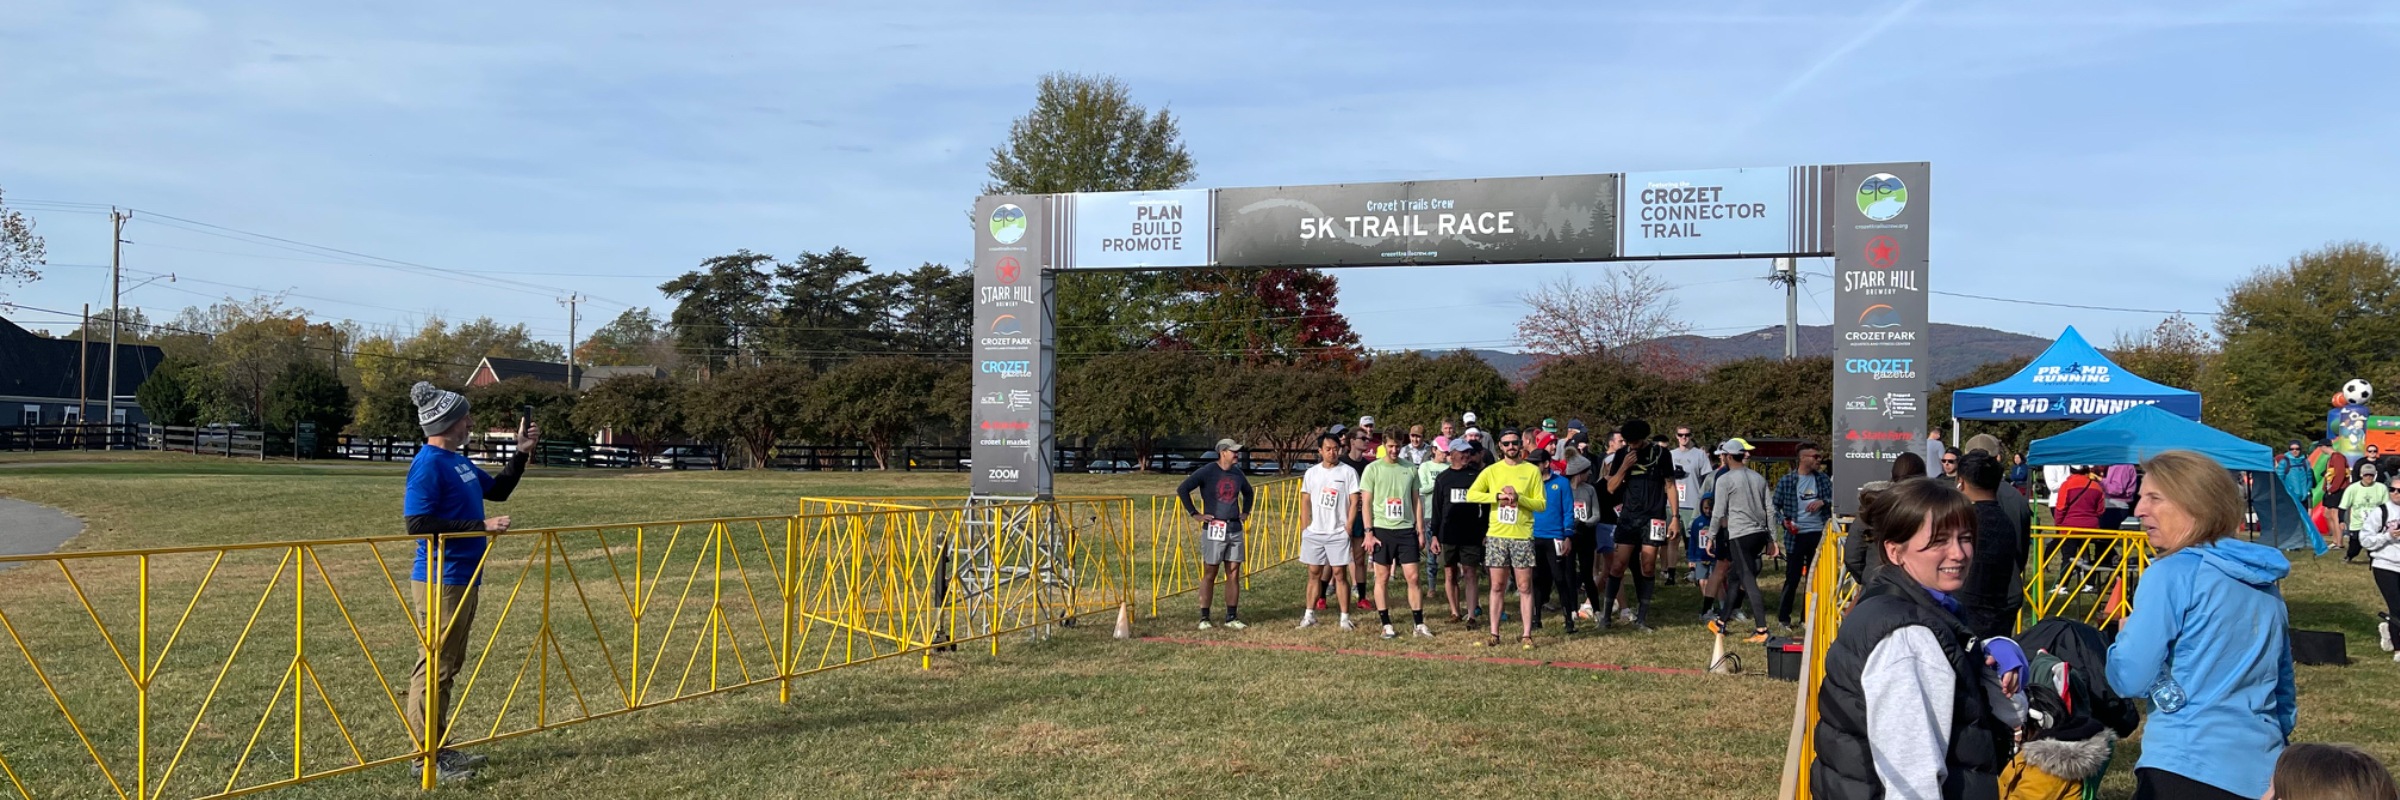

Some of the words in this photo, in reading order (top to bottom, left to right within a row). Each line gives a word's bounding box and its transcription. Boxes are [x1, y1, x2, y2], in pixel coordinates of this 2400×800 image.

[1641, 187, 1723, 205] CROZET
[1367, 200, 1398, 211] Crozet
[1400, 198, 1429, 210] Trails
[1431, 198, 1455, 209] Crew
[1137, 205, 1182, 220] PLAN
[1641, 203, 1766, 221] CONNECTOR
[1132, 221, 1182, 235] BUILD
[1300, 216, 1337, 239] 5K
[1345, 214, 1428, 238] TRAIL
[1438, 211, 1514, 235] RACE
[1641, 222, 1701, 239] TRAIL
[1102, 237, 1182, 252] PROMOTE
[1845, 270, 1885, 292] STARR
[1891, 269, 1919, 292] HILL
[981, 286, 1010, 305] STARR
[1013, 285, 1035, 304] HILL
[981, 337, 1010, 345] CROZET
[1011, 337, 1032, 345] PARK
[1845, 331, 1886, 341] CROZET
[1887, 331, 1916, 340] PARK
[981, 360, 1030, 373] CROZET
[1845, 358, 1913, 374] CROZET
[2037, 366, 2061, 375] PR
[2081, 365, 2109, 374] MD
[1873, 370, 1916, 380] gazette
[2032, 374, 2111, 383] RUNNING
[1991, 398, 2017, 414] PR
[2020, 398, 2049, 414] MD
[1845, 451, 1875, 459] crozet
[988, 469, 1019, 479] ZOOM
[1321, 494, 1336, 508] 155
[1388, 505, 1402, 517] 144
[1500, 508, 1516, 522] 163
[1210, 525, 1225, 538] 175
